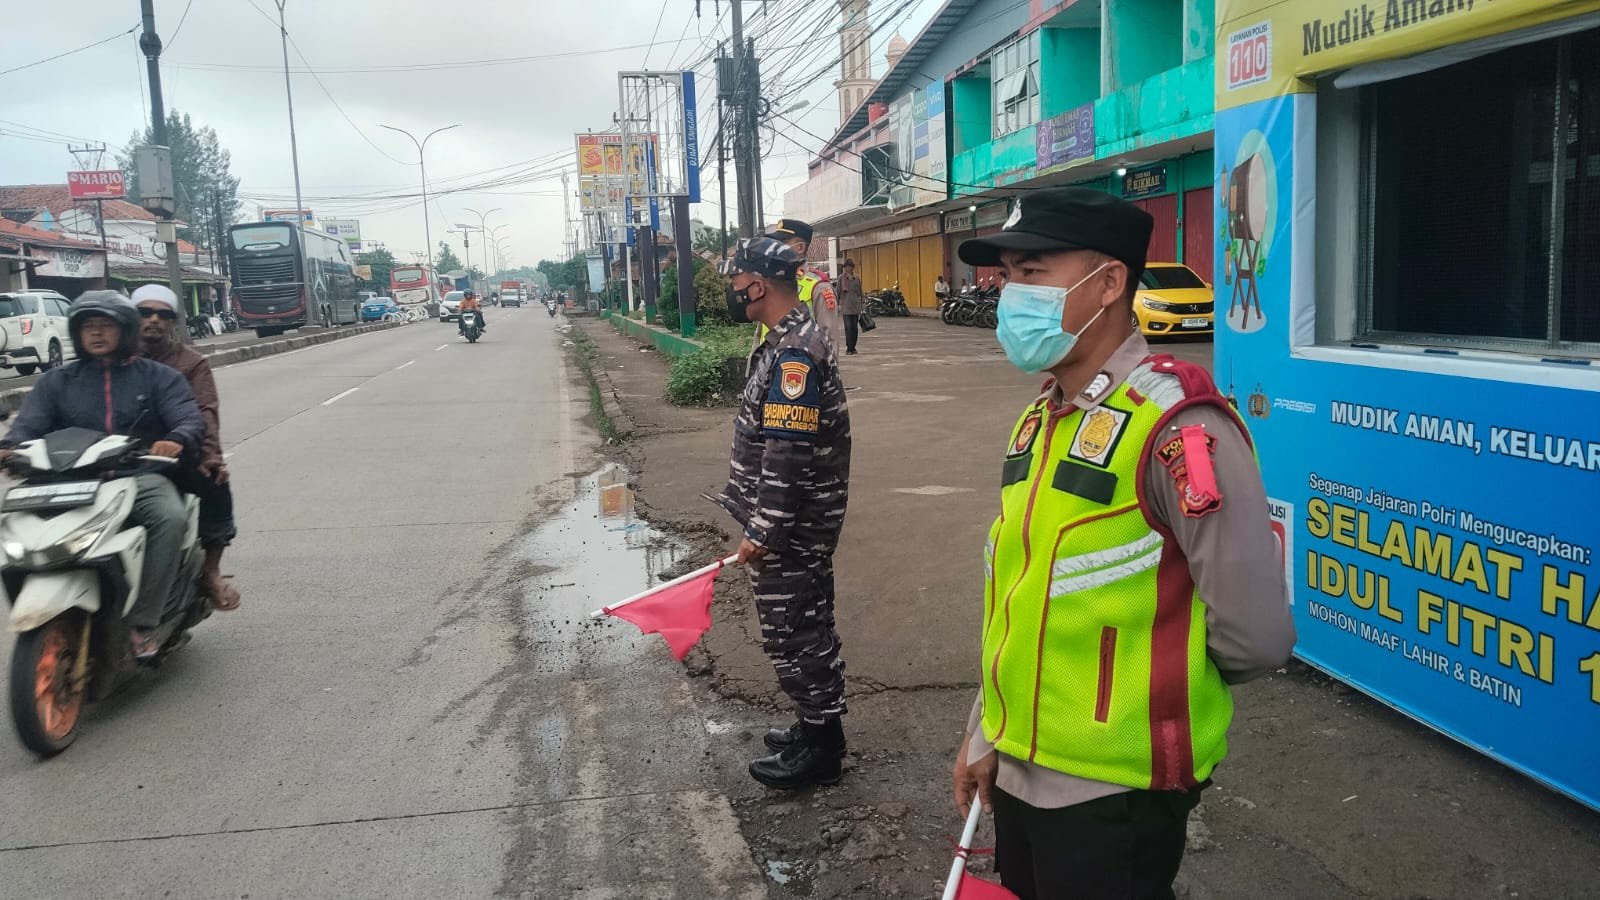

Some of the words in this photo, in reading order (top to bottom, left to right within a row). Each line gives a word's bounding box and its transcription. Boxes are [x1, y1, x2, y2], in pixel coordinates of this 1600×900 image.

[1230, 30, 1252, 44] LAYANAN
[1252, 24, 1268, 35] POLISI
[1303, 4, 1375, 56] Mudik
[1231, 41, 1267, 78] 110
[80, 172, 122, 184] MARIO
[764, 403, 820, 424] BABINPOTMAR
[785, 420, 818, 432] CIREBON
[1273, 398, 1317, 414] PRESISI
[1331, 400, 1399, 434] MUDIK
[1404, 413, 1482, 455] AMAN,
[1308, 472, 1363, 504] Segenap
[1365, 487, 1417, 517] Jajaran
[1421, 502, 1456, 527] Polri
[1460, 511, 1592, 565] Mengucapkan:
[1306, 497, 1523, 600] SELAMAT
[1307, 549, 1403, 624] IDUL
[1417, 589, 1555, 684] FITRI
[1308, 600, 1357, 636] MOHON
[1360, 623, 1400, 652] MAAF
[1403, 640, 1449, 676] LAHIR
[1454, 662, 1466, 682] &
[1470, 669, 1522, 708] BATIN
